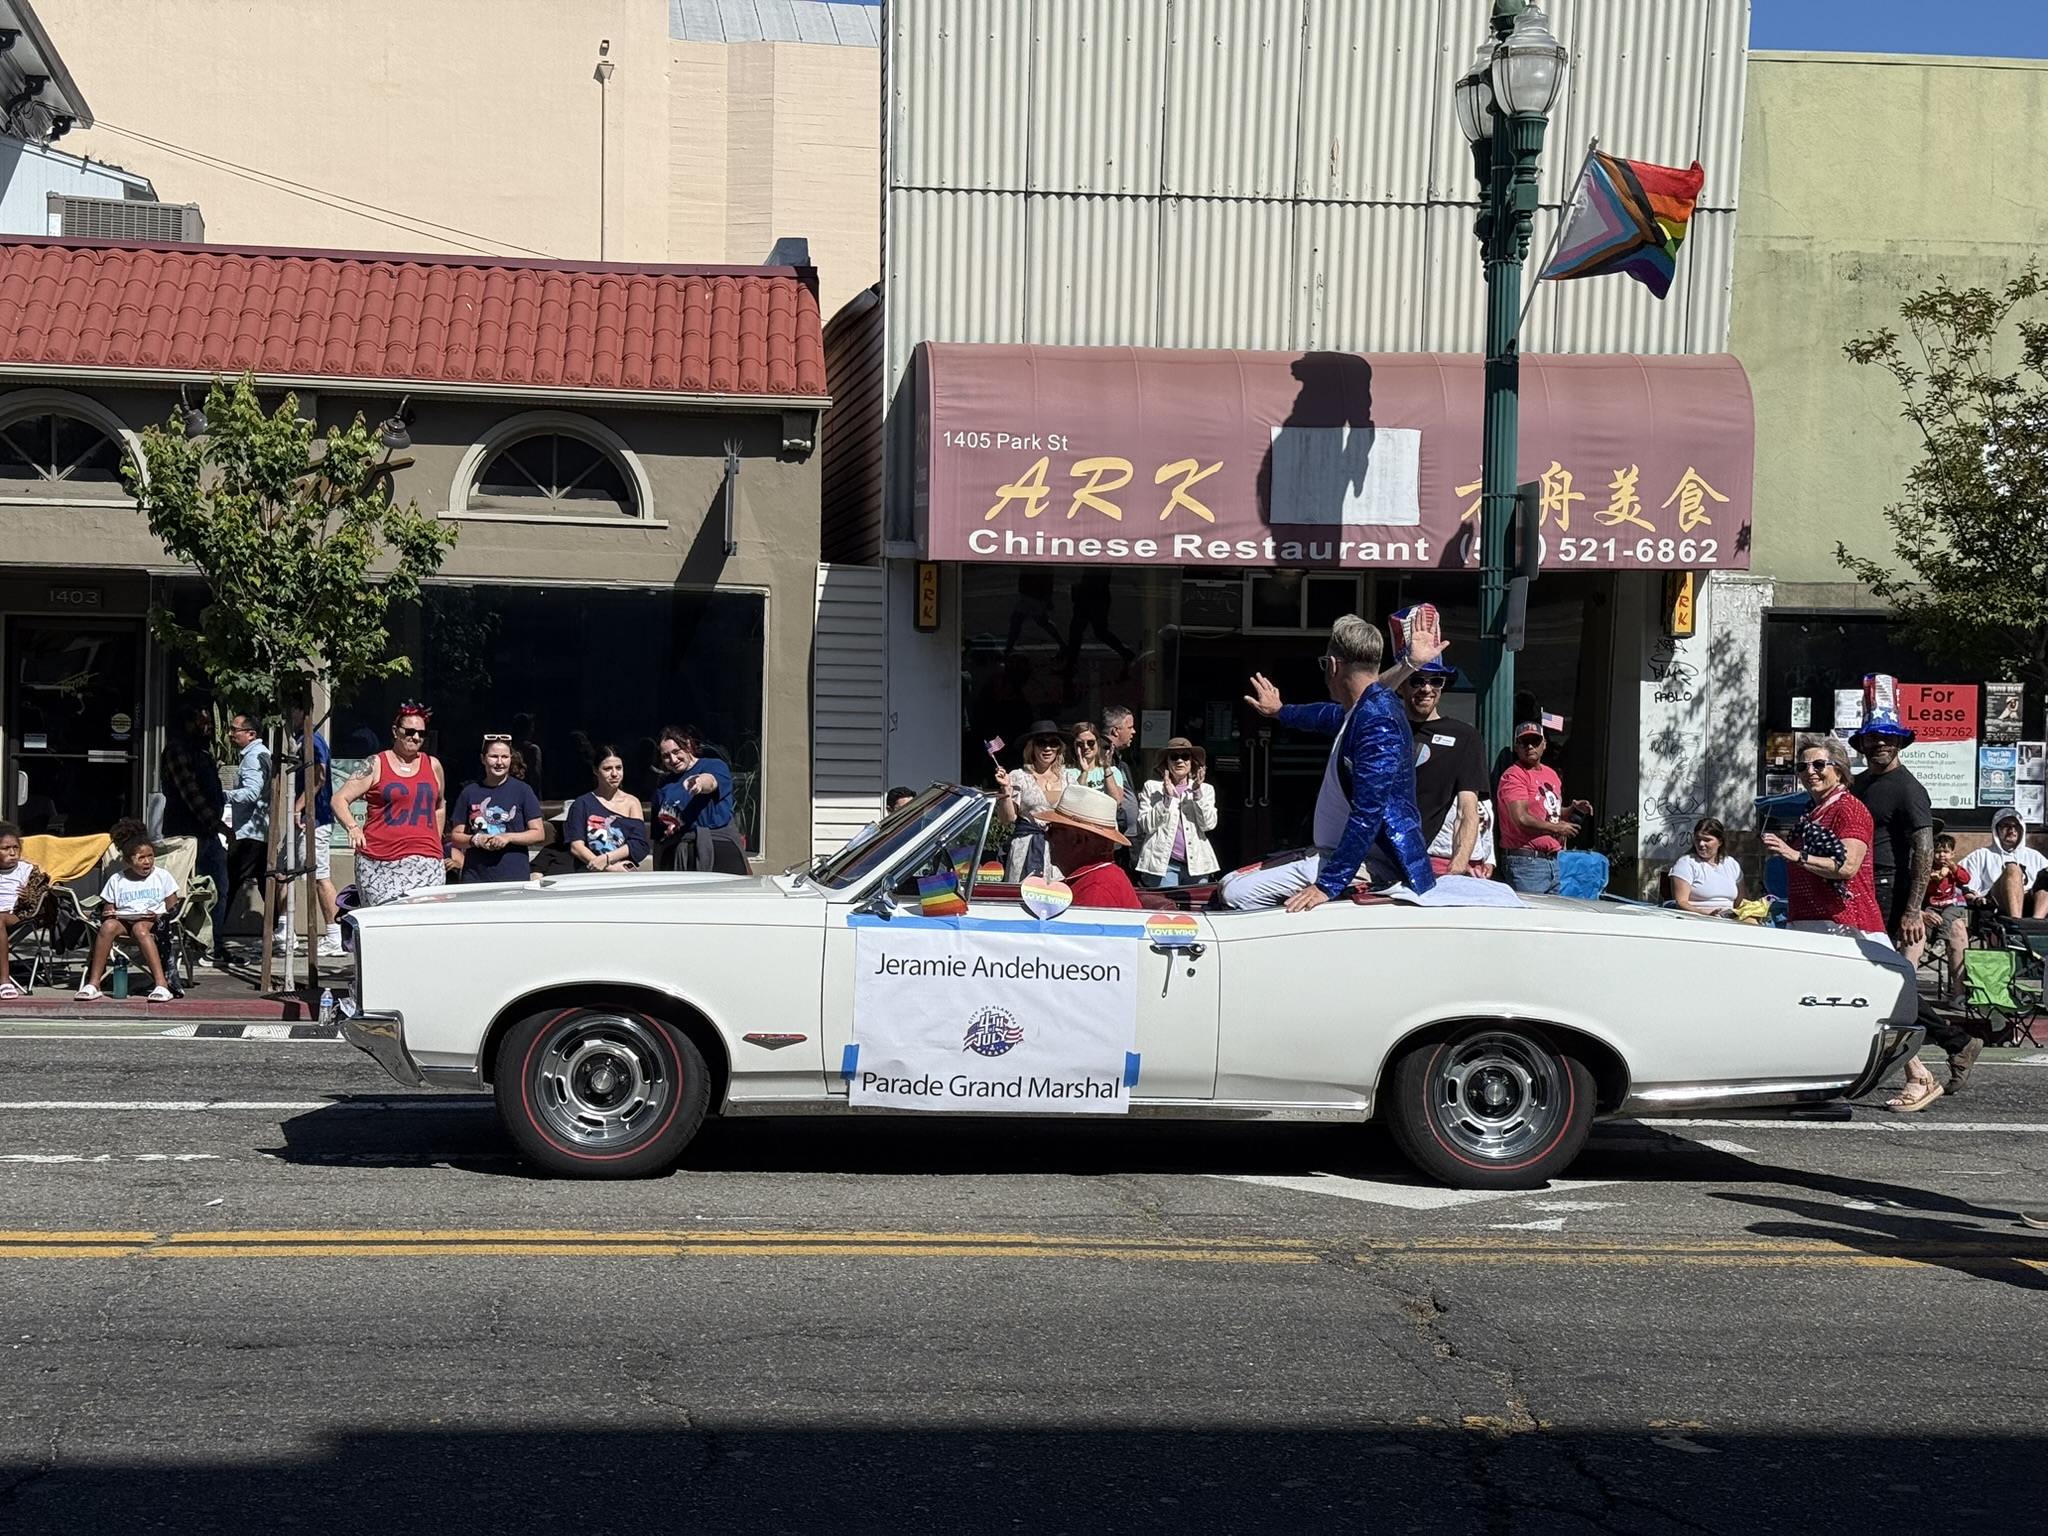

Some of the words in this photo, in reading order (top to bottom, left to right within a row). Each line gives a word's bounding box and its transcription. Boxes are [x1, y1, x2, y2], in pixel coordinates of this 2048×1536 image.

[943, 431, 991, 449] 1405
[997, 433, 1042, 450] Park
[1047, 434, 1069, 452] St
[985, 456, 1224, 524] ARK
[967, 529, 1157, 559] Chinese
[1173, 532, 1429, 564] Restaurant
[1558, 537, 1718, 563] 521-6862
[49, 590, 98, 604] 1403
[922, 569, 935, 620] ARK
[1654, 691, 1692, 703] PABLO
[1920, 687, 1955, 703] For
[1907, 705, 1966, 721] Lease
[1899, 751, 1925, 759] Justin
[1928, 751, 1949, 759] Choi
[1916, 772, 1965, 780] Badstubner
[383, 782, 434, 829] CA
[1959, 797, 1973, 806] JLL
[1023, 891, 1046, 902] LOVE
[1047, 895, 1070, 905] WINS
[1150, 928, 1173, 936] LOVE
[1174, 928, 1196, 936] WINS
[875, 953, 966, 977] Jeramie
[972, 956, 1121, 982] Andehueson
[1799, 996, 1869, 1008] GTO
[968, 1011, 978, 1024] CITY
[992, 1005, 1016, 1025] ALAMEDA
[980, 1011, 1004, 1034] 4TH
[974, 1030, 1008, 1047] JULY
[862, 1072, 944, 1097] Parade
[949, 1075, 1021, 1099] Grand
[1028, 1076, 1120, 1100] Marshal
